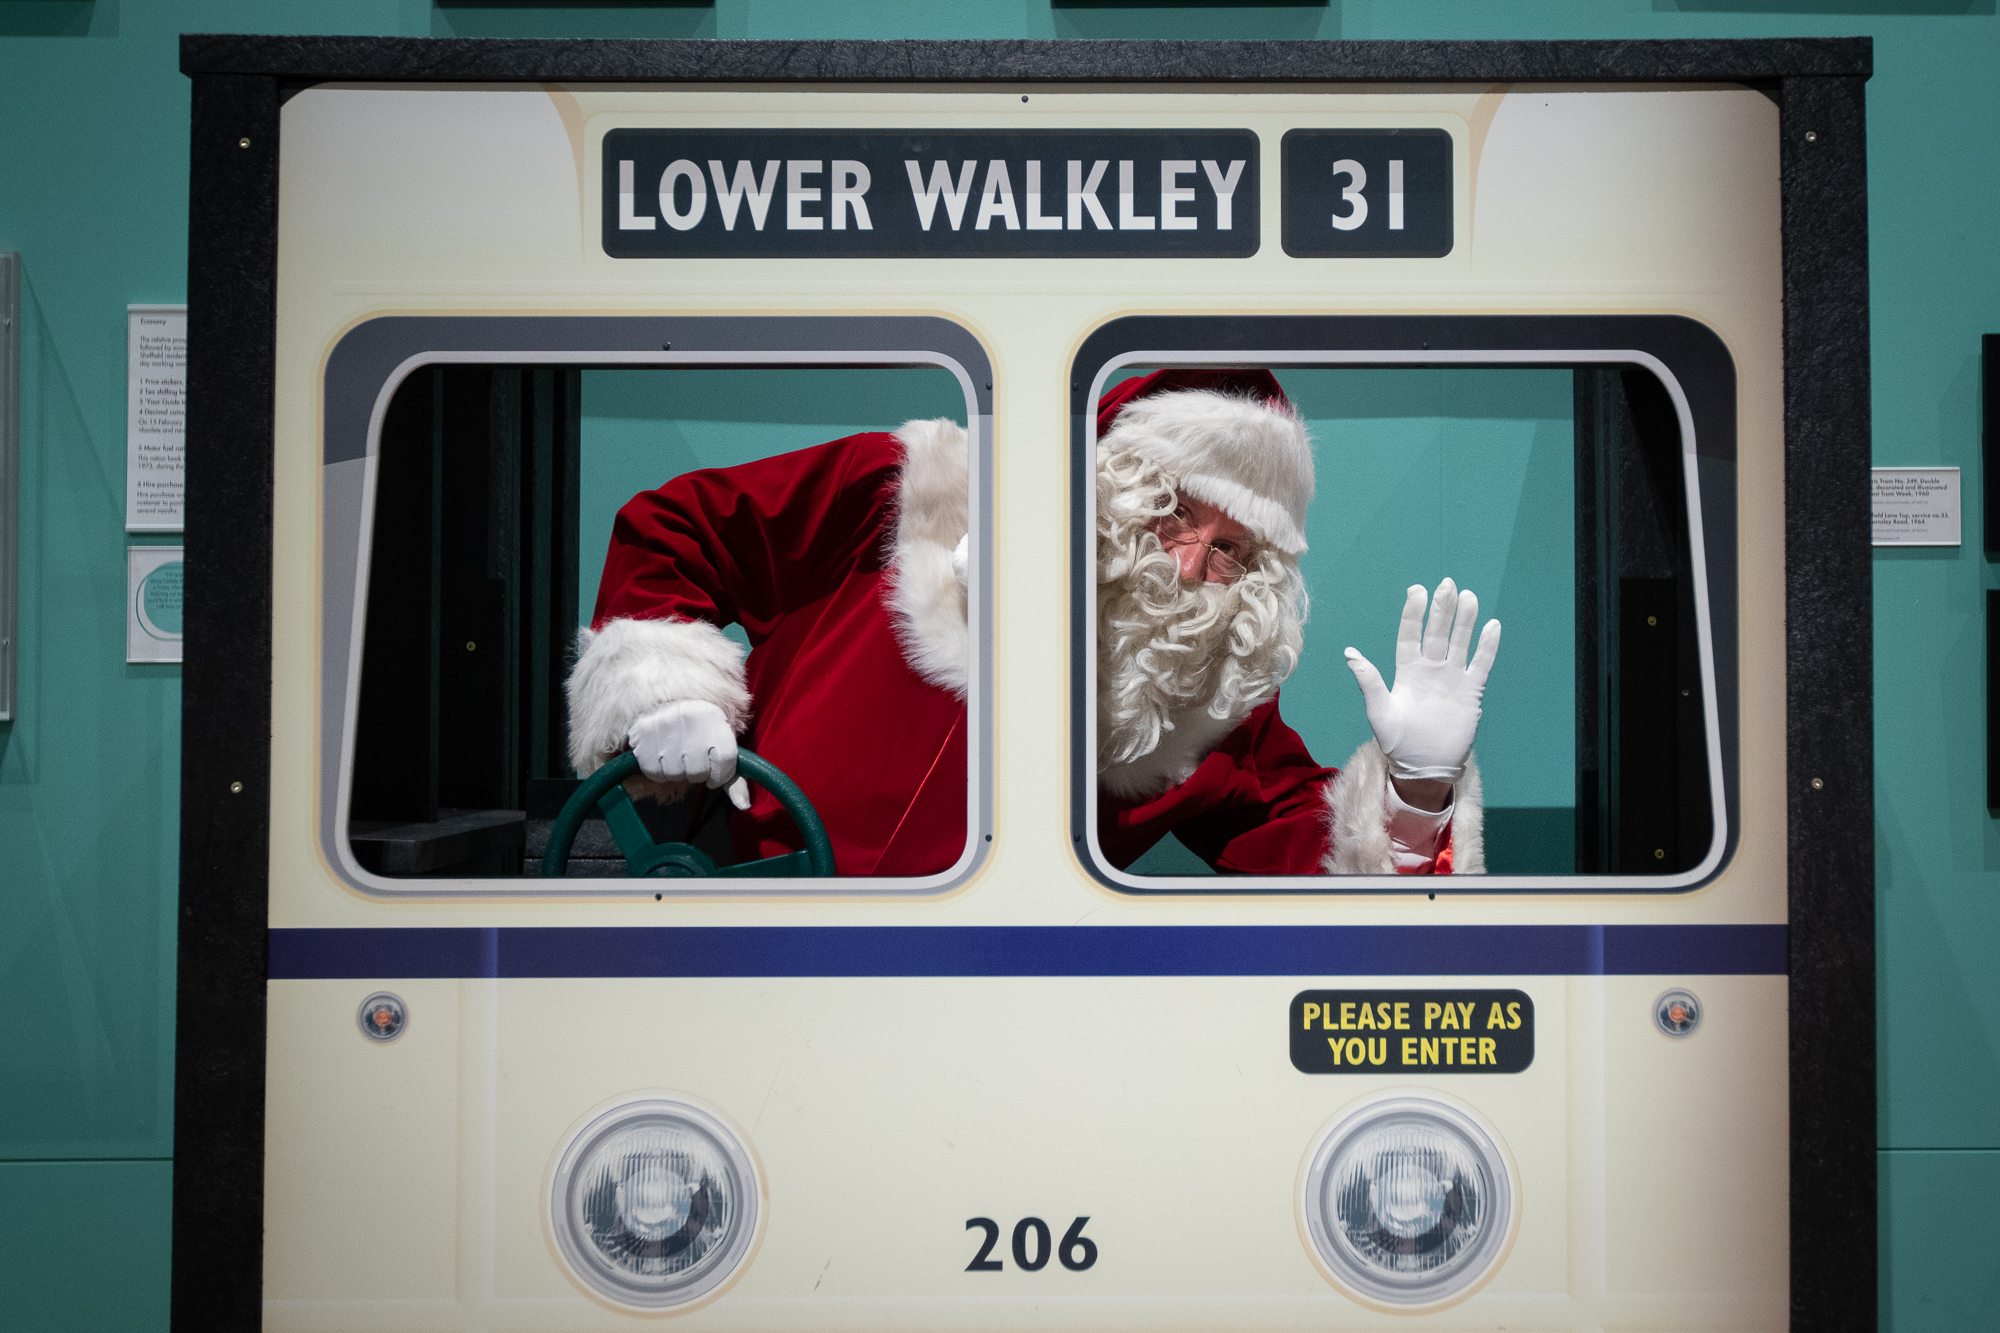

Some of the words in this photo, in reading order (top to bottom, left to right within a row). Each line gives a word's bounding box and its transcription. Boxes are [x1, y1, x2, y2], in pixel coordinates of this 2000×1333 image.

[619, 158, 873, 231] LOWER
[904, 159, 1246, 231] WALKLEY
[1332, 159, 1404, 231] 31
[140, 317, 166, 327] Economy
[140, 335, 150, 343] The
[151, 335, 171, 343] relative
[140, 351, 163, 359] Sheffield
[151, 359, 174, 369] working
[145, 377, 160, 385] Price
[156, 387, 178, 397] shilling
[161, 397, 180, 406] Guide
[144, 407, 168, 416] Decimal
[158, 418, 183, 427] February
[162, 443, 174, 452] fuel
[155, 462, 175, 471] during
[142, 480, 156, 488] Hire
[149, 490, 175, 499] purchase
[1303, 1002, 1410, 1030] PLEASE
[1424, 1002, 1476, 1030] PAY
[1486, 1002, 1522, 1030] AS
[1327, 1037, 1387, 1065] YOU
[1402, 1037, 1497, 1065] ENTER
[964, 1216, 1098, 1272] 206
